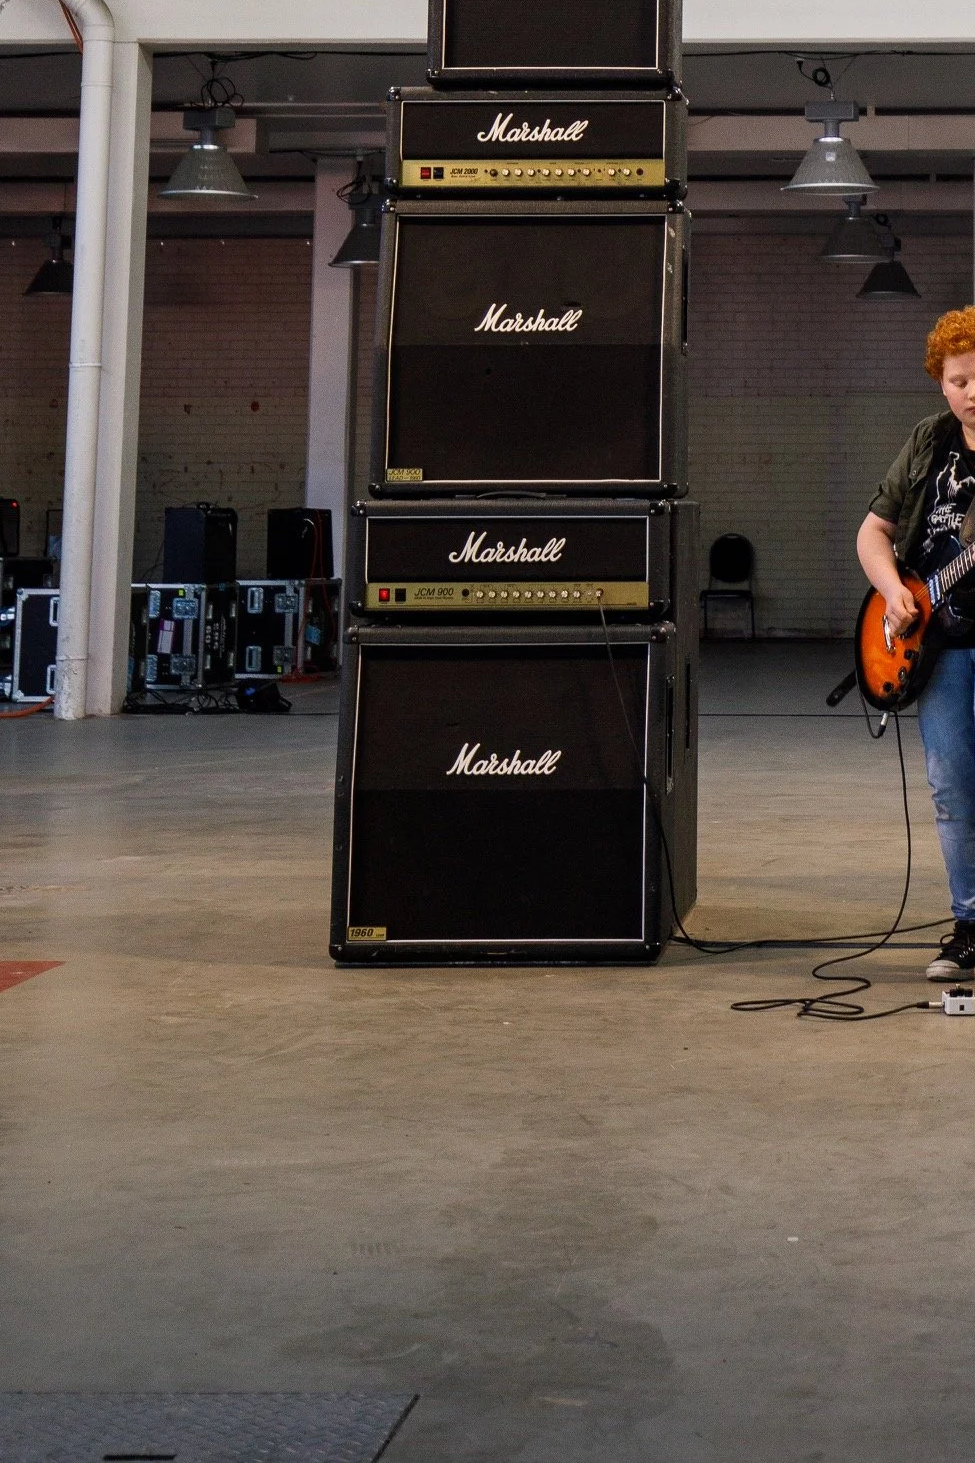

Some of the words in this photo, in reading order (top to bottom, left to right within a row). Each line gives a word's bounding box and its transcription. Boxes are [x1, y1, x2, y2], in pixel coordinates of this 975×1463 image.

[476, 112, 589, 142] Marshall
[474, 302, 583, 333] Marshall
[448, 531, 567, 563] Marshall
[414, 588, 435, 596] JCM
[437, 587, 454, 596] 900
[446, 742, 562, 776] Marshall
[350, 928, 374, 937] 1960
